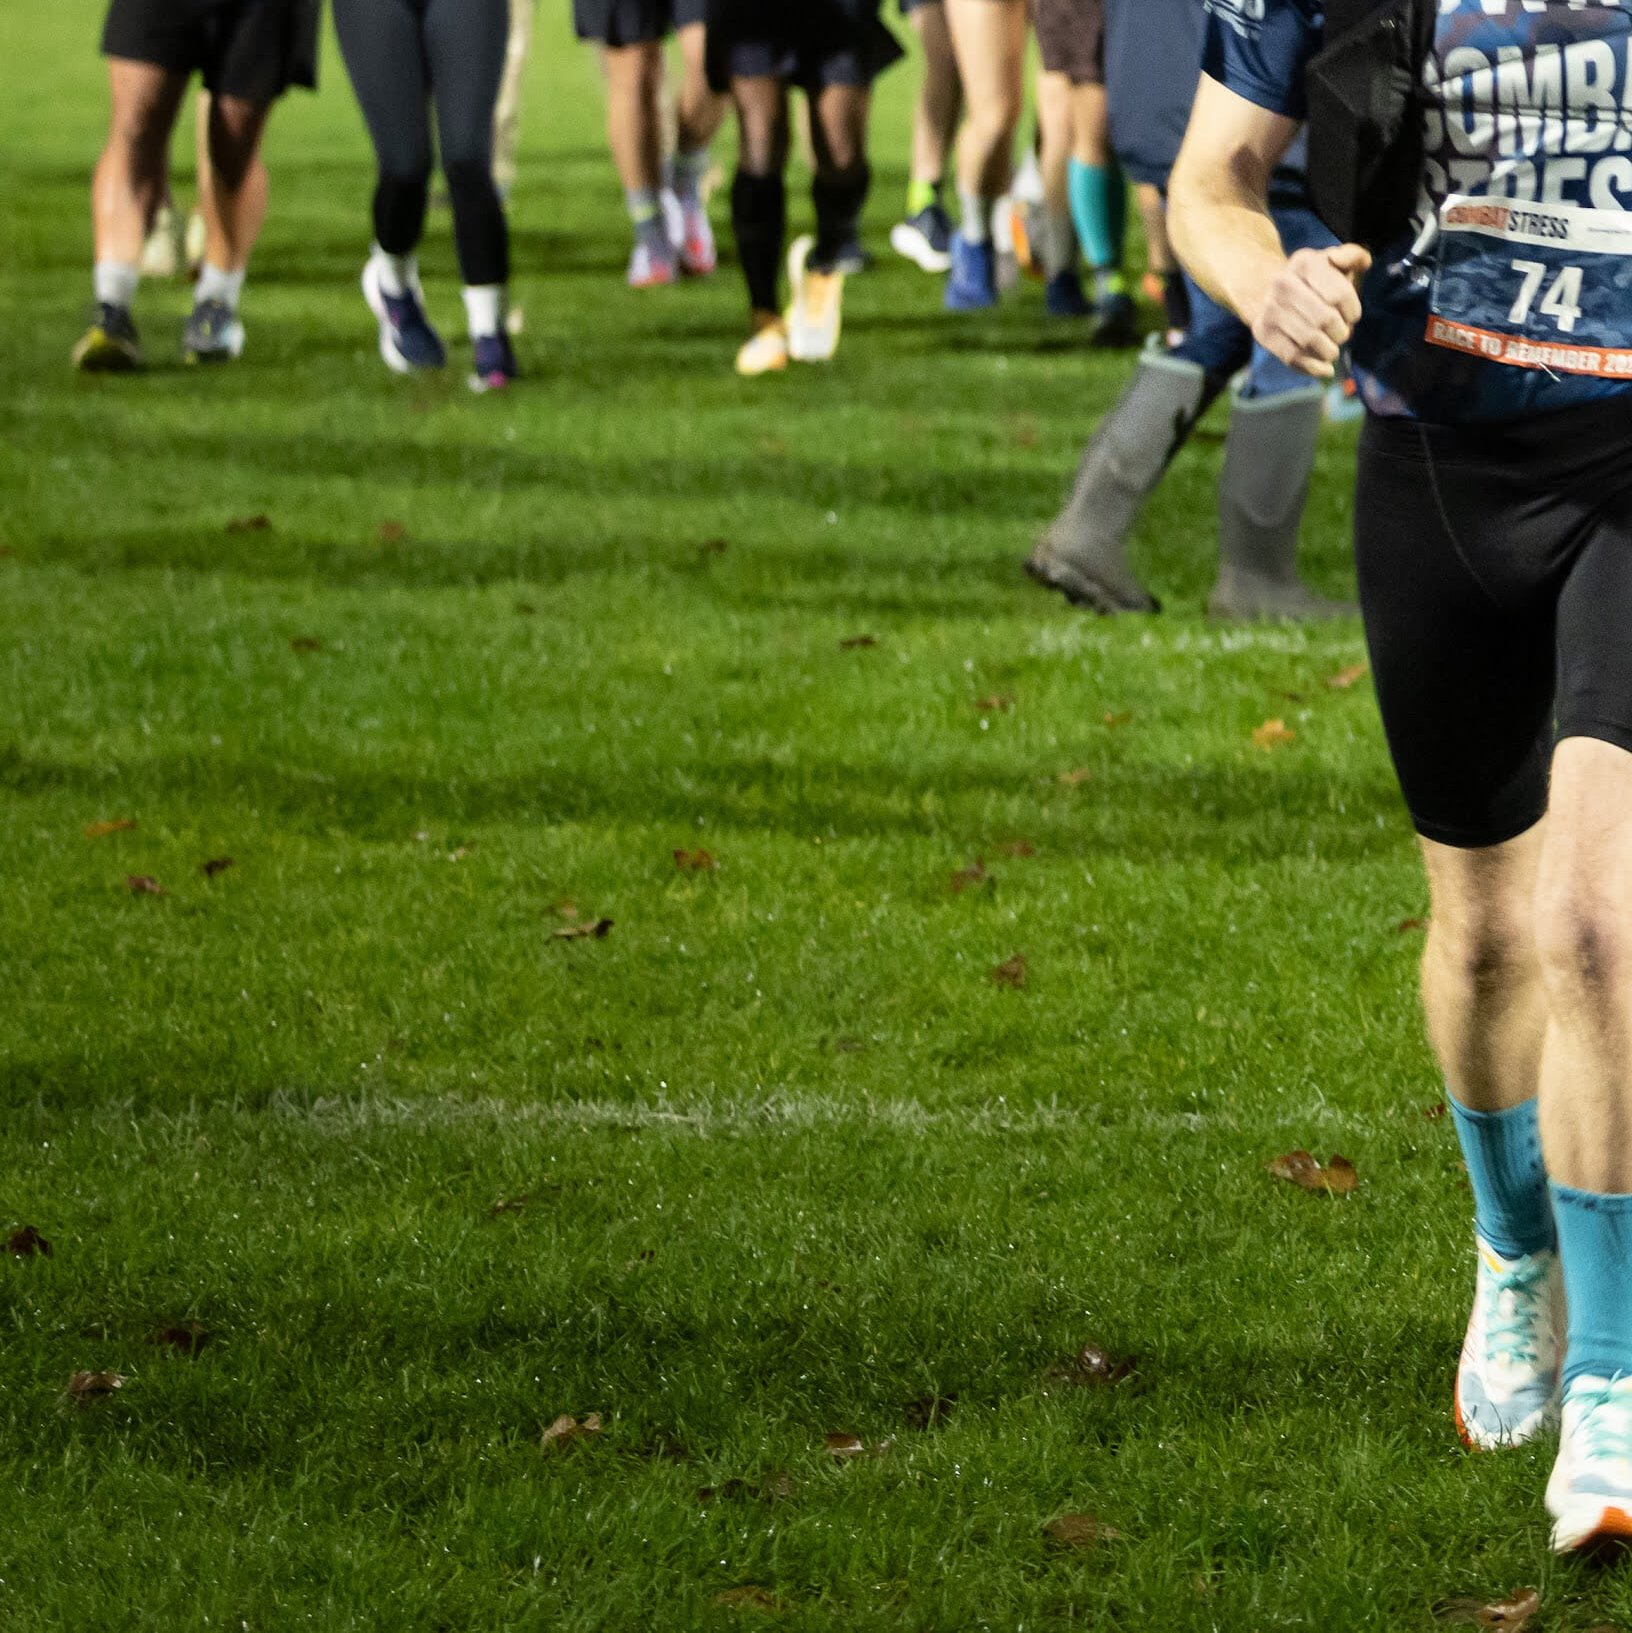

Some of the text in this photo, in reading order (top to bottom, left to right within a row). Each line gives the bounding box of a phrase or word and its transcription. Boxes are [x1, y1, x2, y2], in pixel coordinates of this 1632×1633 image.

[1507, 259, 1583, 332] 74
[1431, 321, 1477, 350] RACE
[1479, 335, 1501, 357] TO
[1504, 341, 1602, 372] REMEMBER
